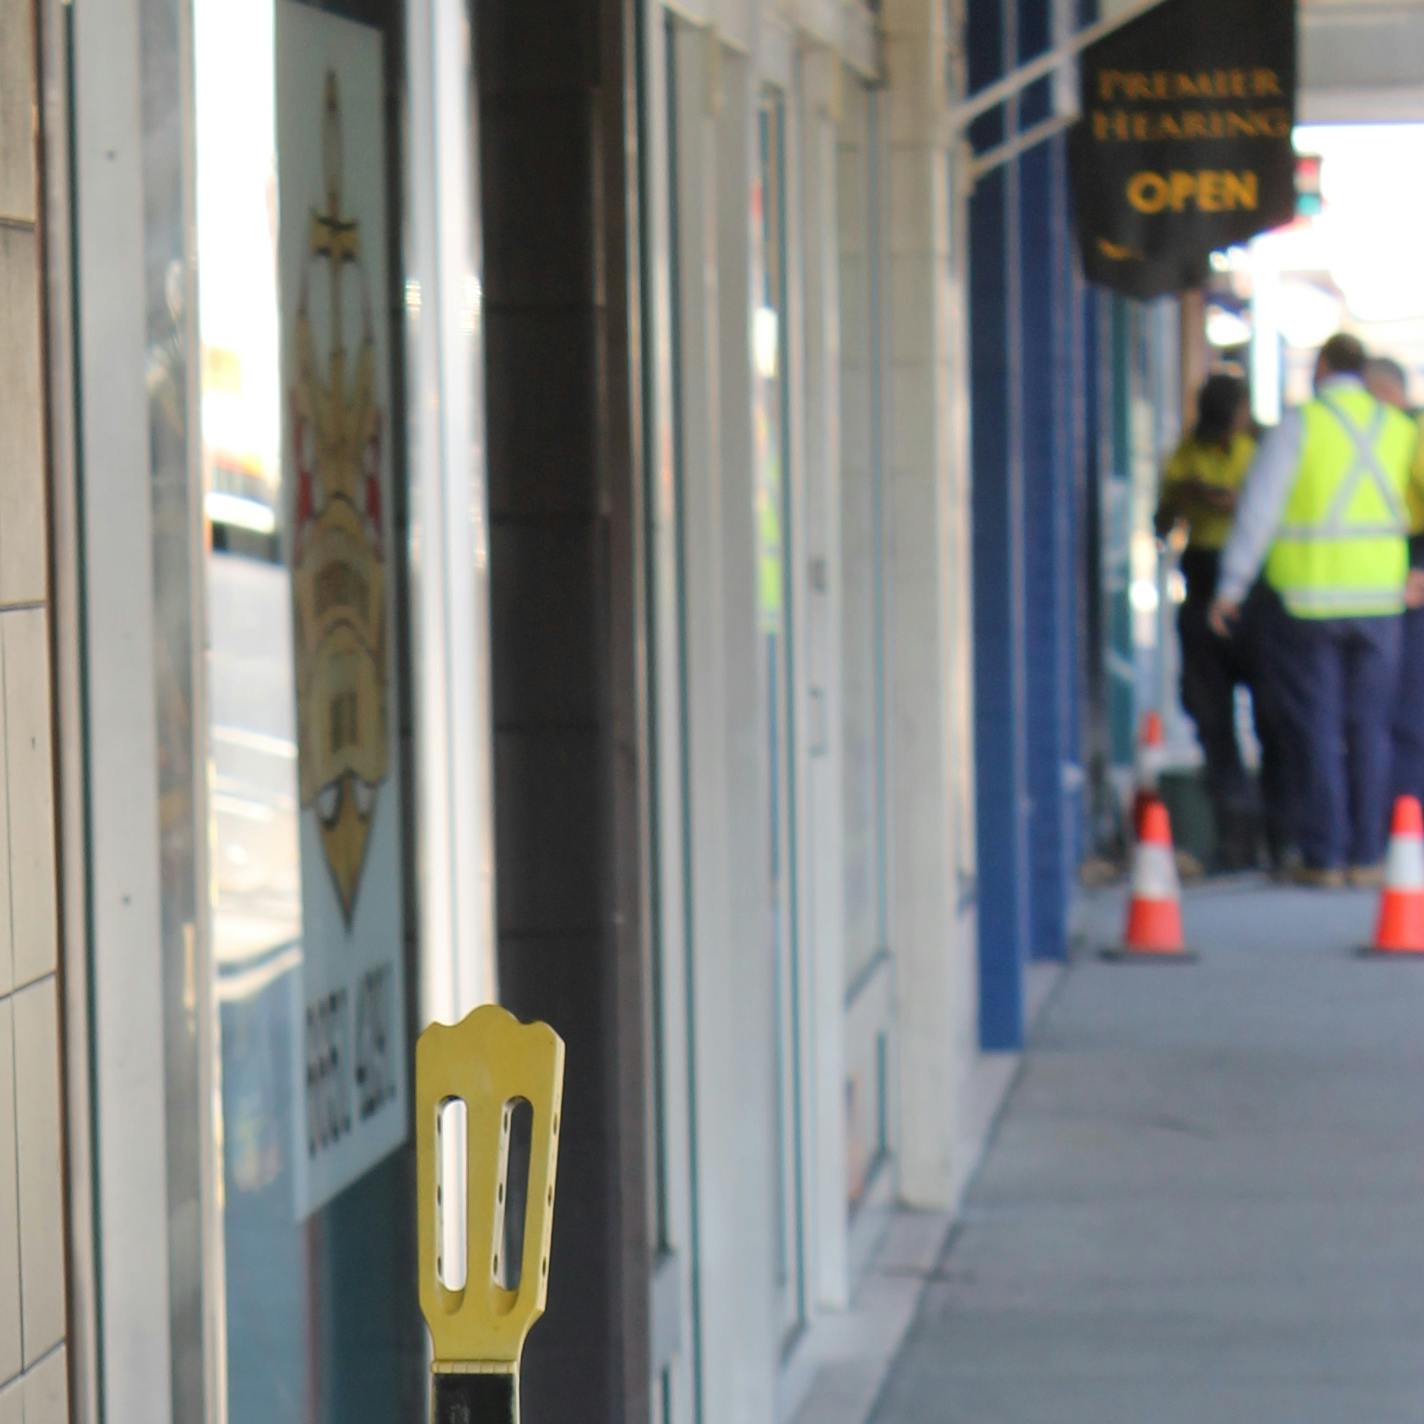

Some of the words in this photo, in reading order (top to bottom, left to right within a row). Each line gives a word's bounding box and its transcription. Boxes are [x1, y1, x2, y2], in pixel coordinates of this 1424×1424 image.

[1098, 67, 1283, 101] PREMIER
[1093, 108, 1289, 141] HEARING
[1127, 169, 1258, 214] OPEN
